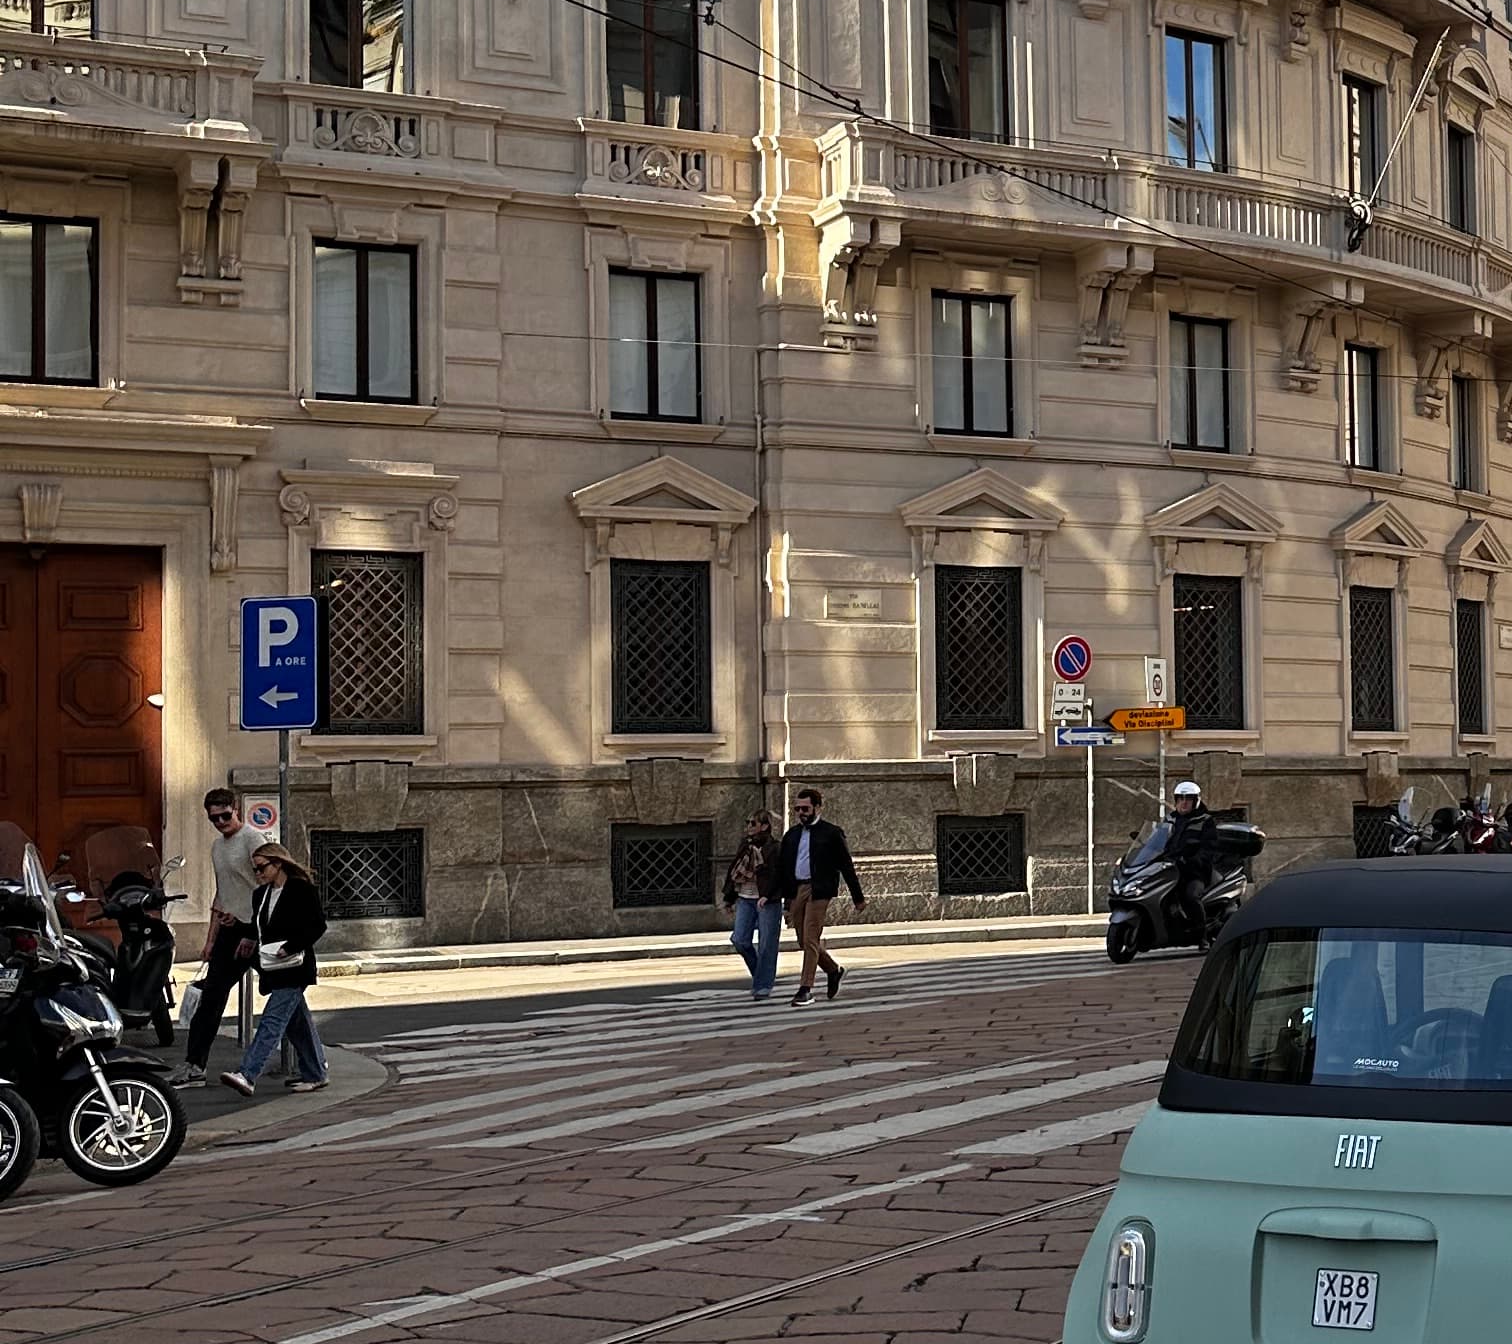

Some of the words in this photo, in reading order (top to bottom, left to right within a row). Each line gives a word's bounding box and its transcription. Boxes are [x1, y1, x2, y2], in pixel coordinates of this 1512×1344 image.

[259, 607, 299, 667] P
[275, 657, 282, 666] A
[285, 656, 307, 666] ORE
[1071, 688, 1081, 696] 24
[1124, 720, 1137, 728] Via
[1353, 1058, 1400, 1067] MOCAUTO
[1334, 1134, 1382, 1169] FIAT
[1324, 1273, 1370, 1299] XB8
[1323, 1299, 1368, 1325] VM7
